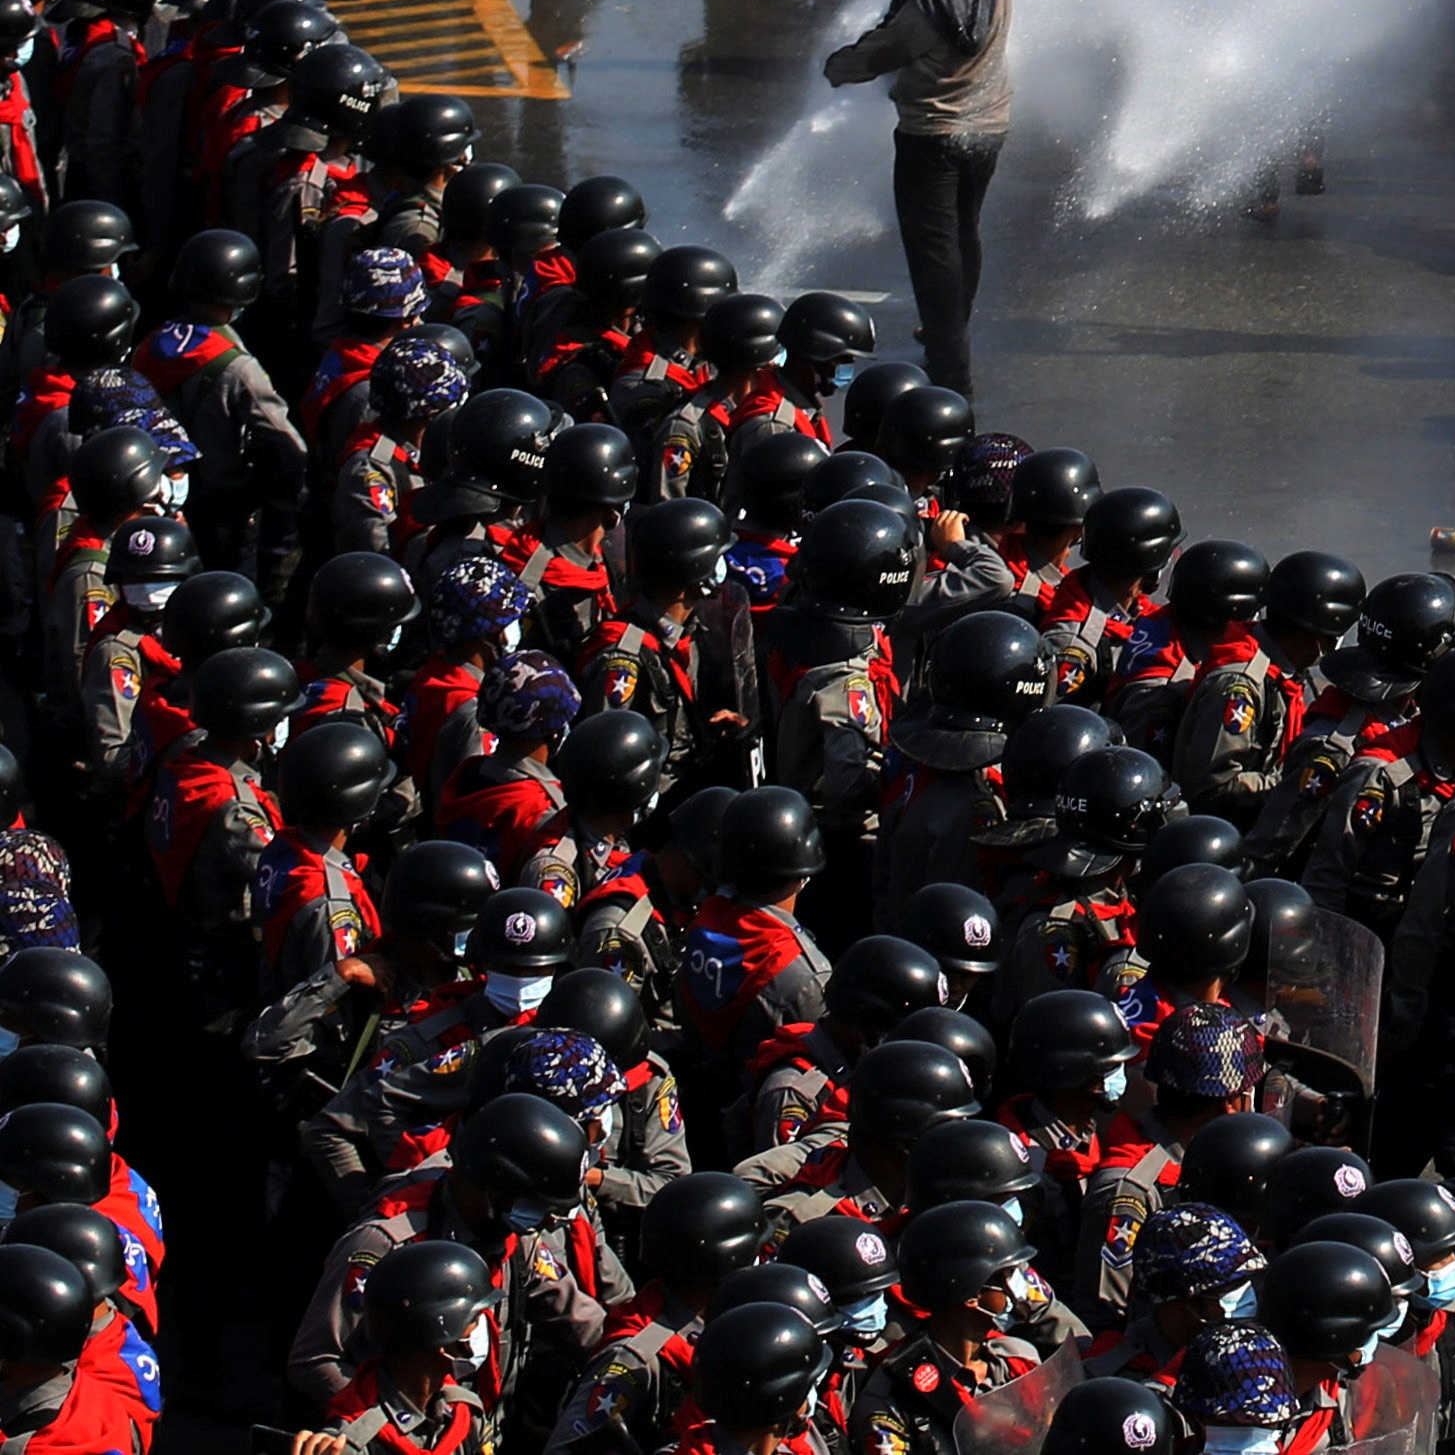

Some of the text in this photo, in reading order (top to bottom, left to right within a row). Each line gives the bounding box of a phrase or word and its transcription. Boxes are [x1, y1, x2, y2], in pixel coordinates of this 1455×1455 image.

[339, 94, 371, 113] POLICE
[510, 448, 546, 469] POLICE
[879, 571, 910, 584] POLICE
[1015, 681, 1046, 695] POLICE
